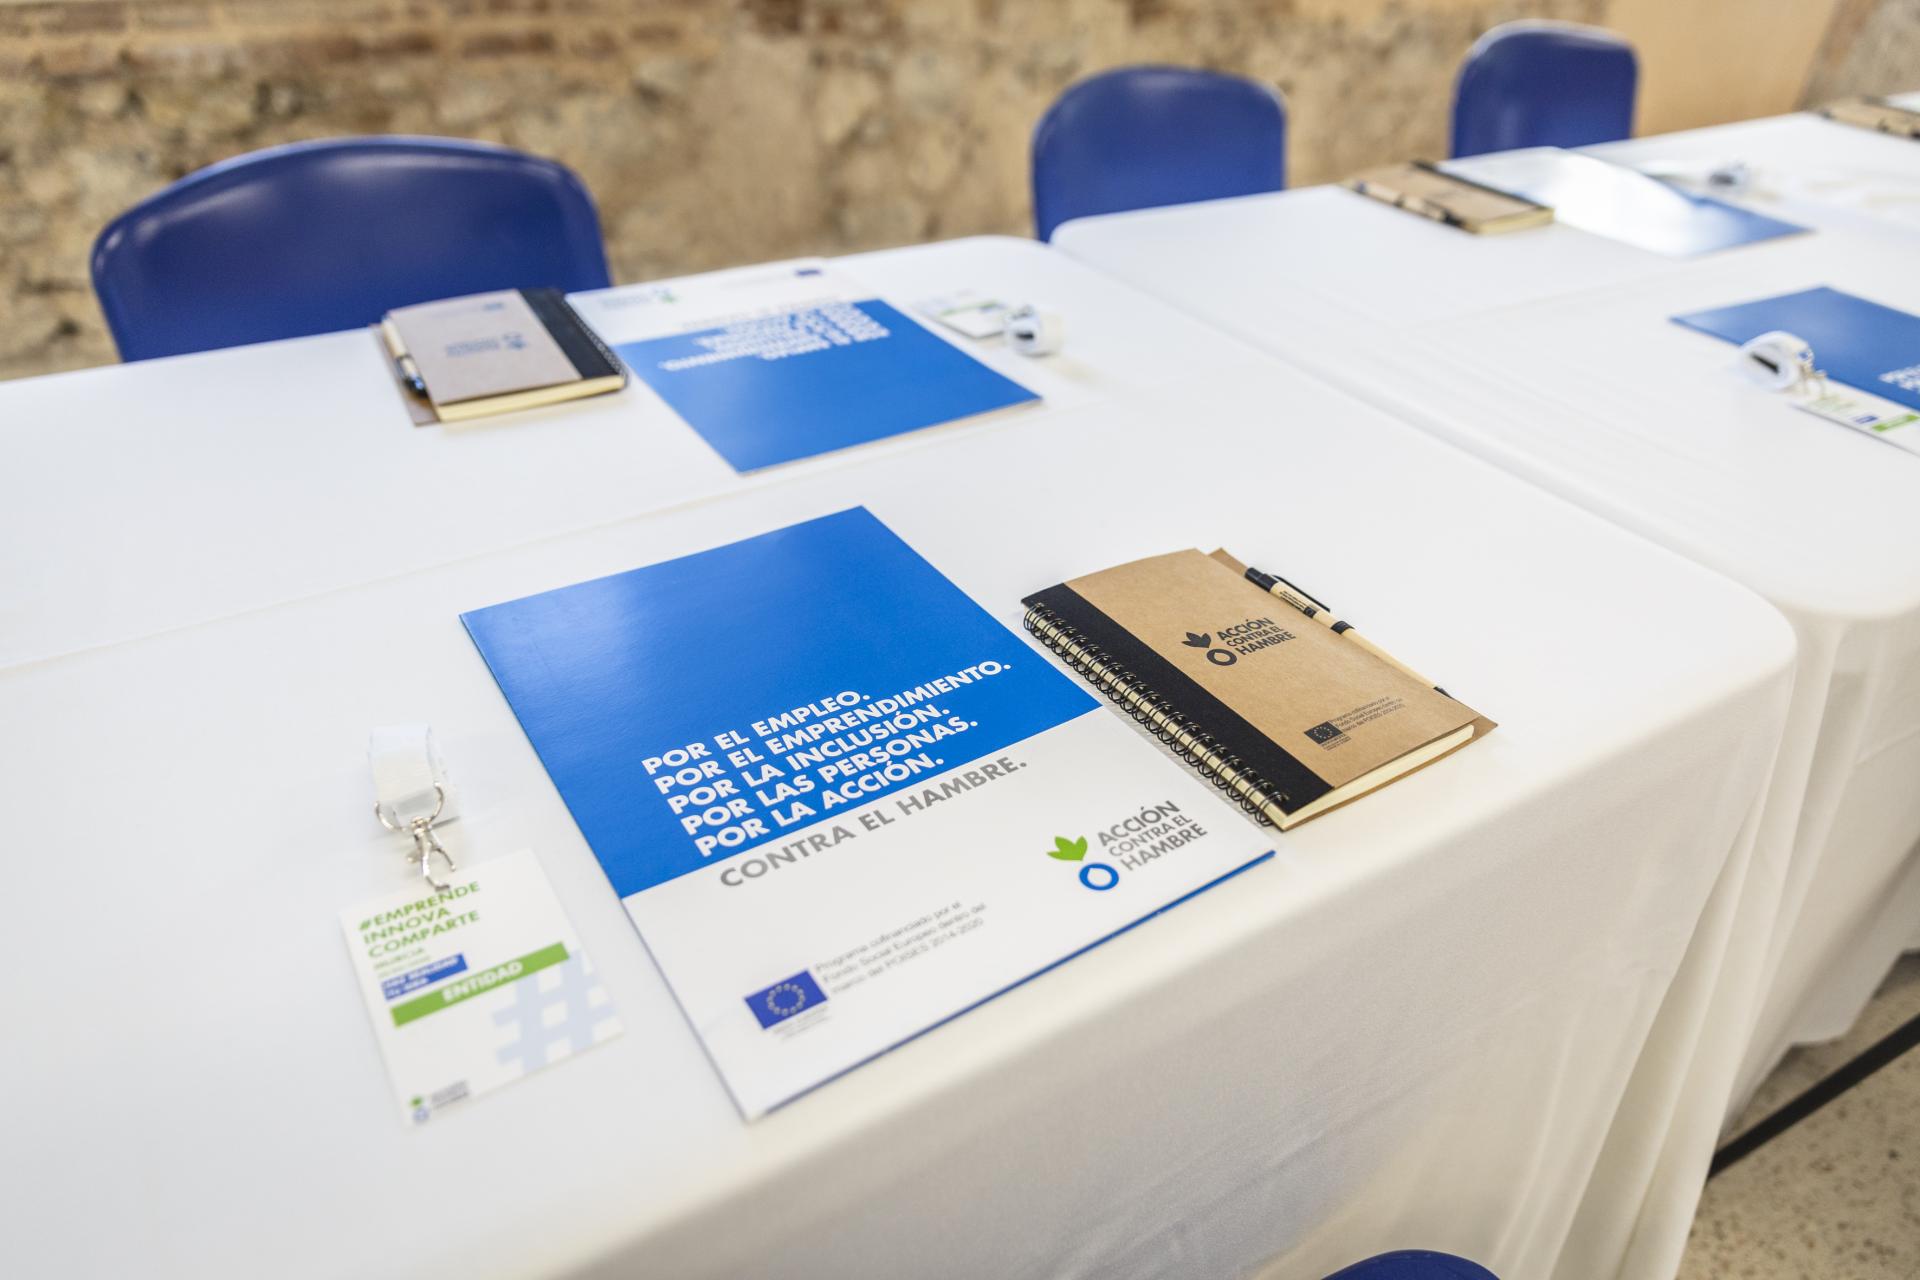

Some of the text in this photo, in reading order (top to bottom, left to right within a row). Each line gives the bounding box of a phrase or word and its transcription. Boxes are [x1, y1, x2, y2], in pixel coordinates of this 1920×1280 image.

[1216, 617, 1275, 641] ACCIÓN
[1226, 625, 1284, 647] CONTRA EL
[1235, 632, 1297, 656] HAMBRE
[641, 690, 871, 775] POR EL EMPLEO.
[654, 660, 1012, 795] POR EL EMPRENDIMIENTO.
[667, 703, 951, 815] POR LA INCLUSIÓN.
[680, 715, 978, 835] POR LAS PERSONAS.
[694, 755, 945, 858] POR LA ACCIÓN.
[719, 755, 1028, 887] CONTRA EL HAMBRE.
[1097, 800, 1181, 847] ACCIÓN
[1109, 814, 1193, 857] CONTRA EL
[1120, 823, 1208, 871] HAMBRE
[359, 881, 481, 931] #EMPRENDE
[364, 907, 450, 944] INNOVA
[368, 910, 481, 958] COMPARTE
[442, 961, 524, 1003] ENTIDAD
